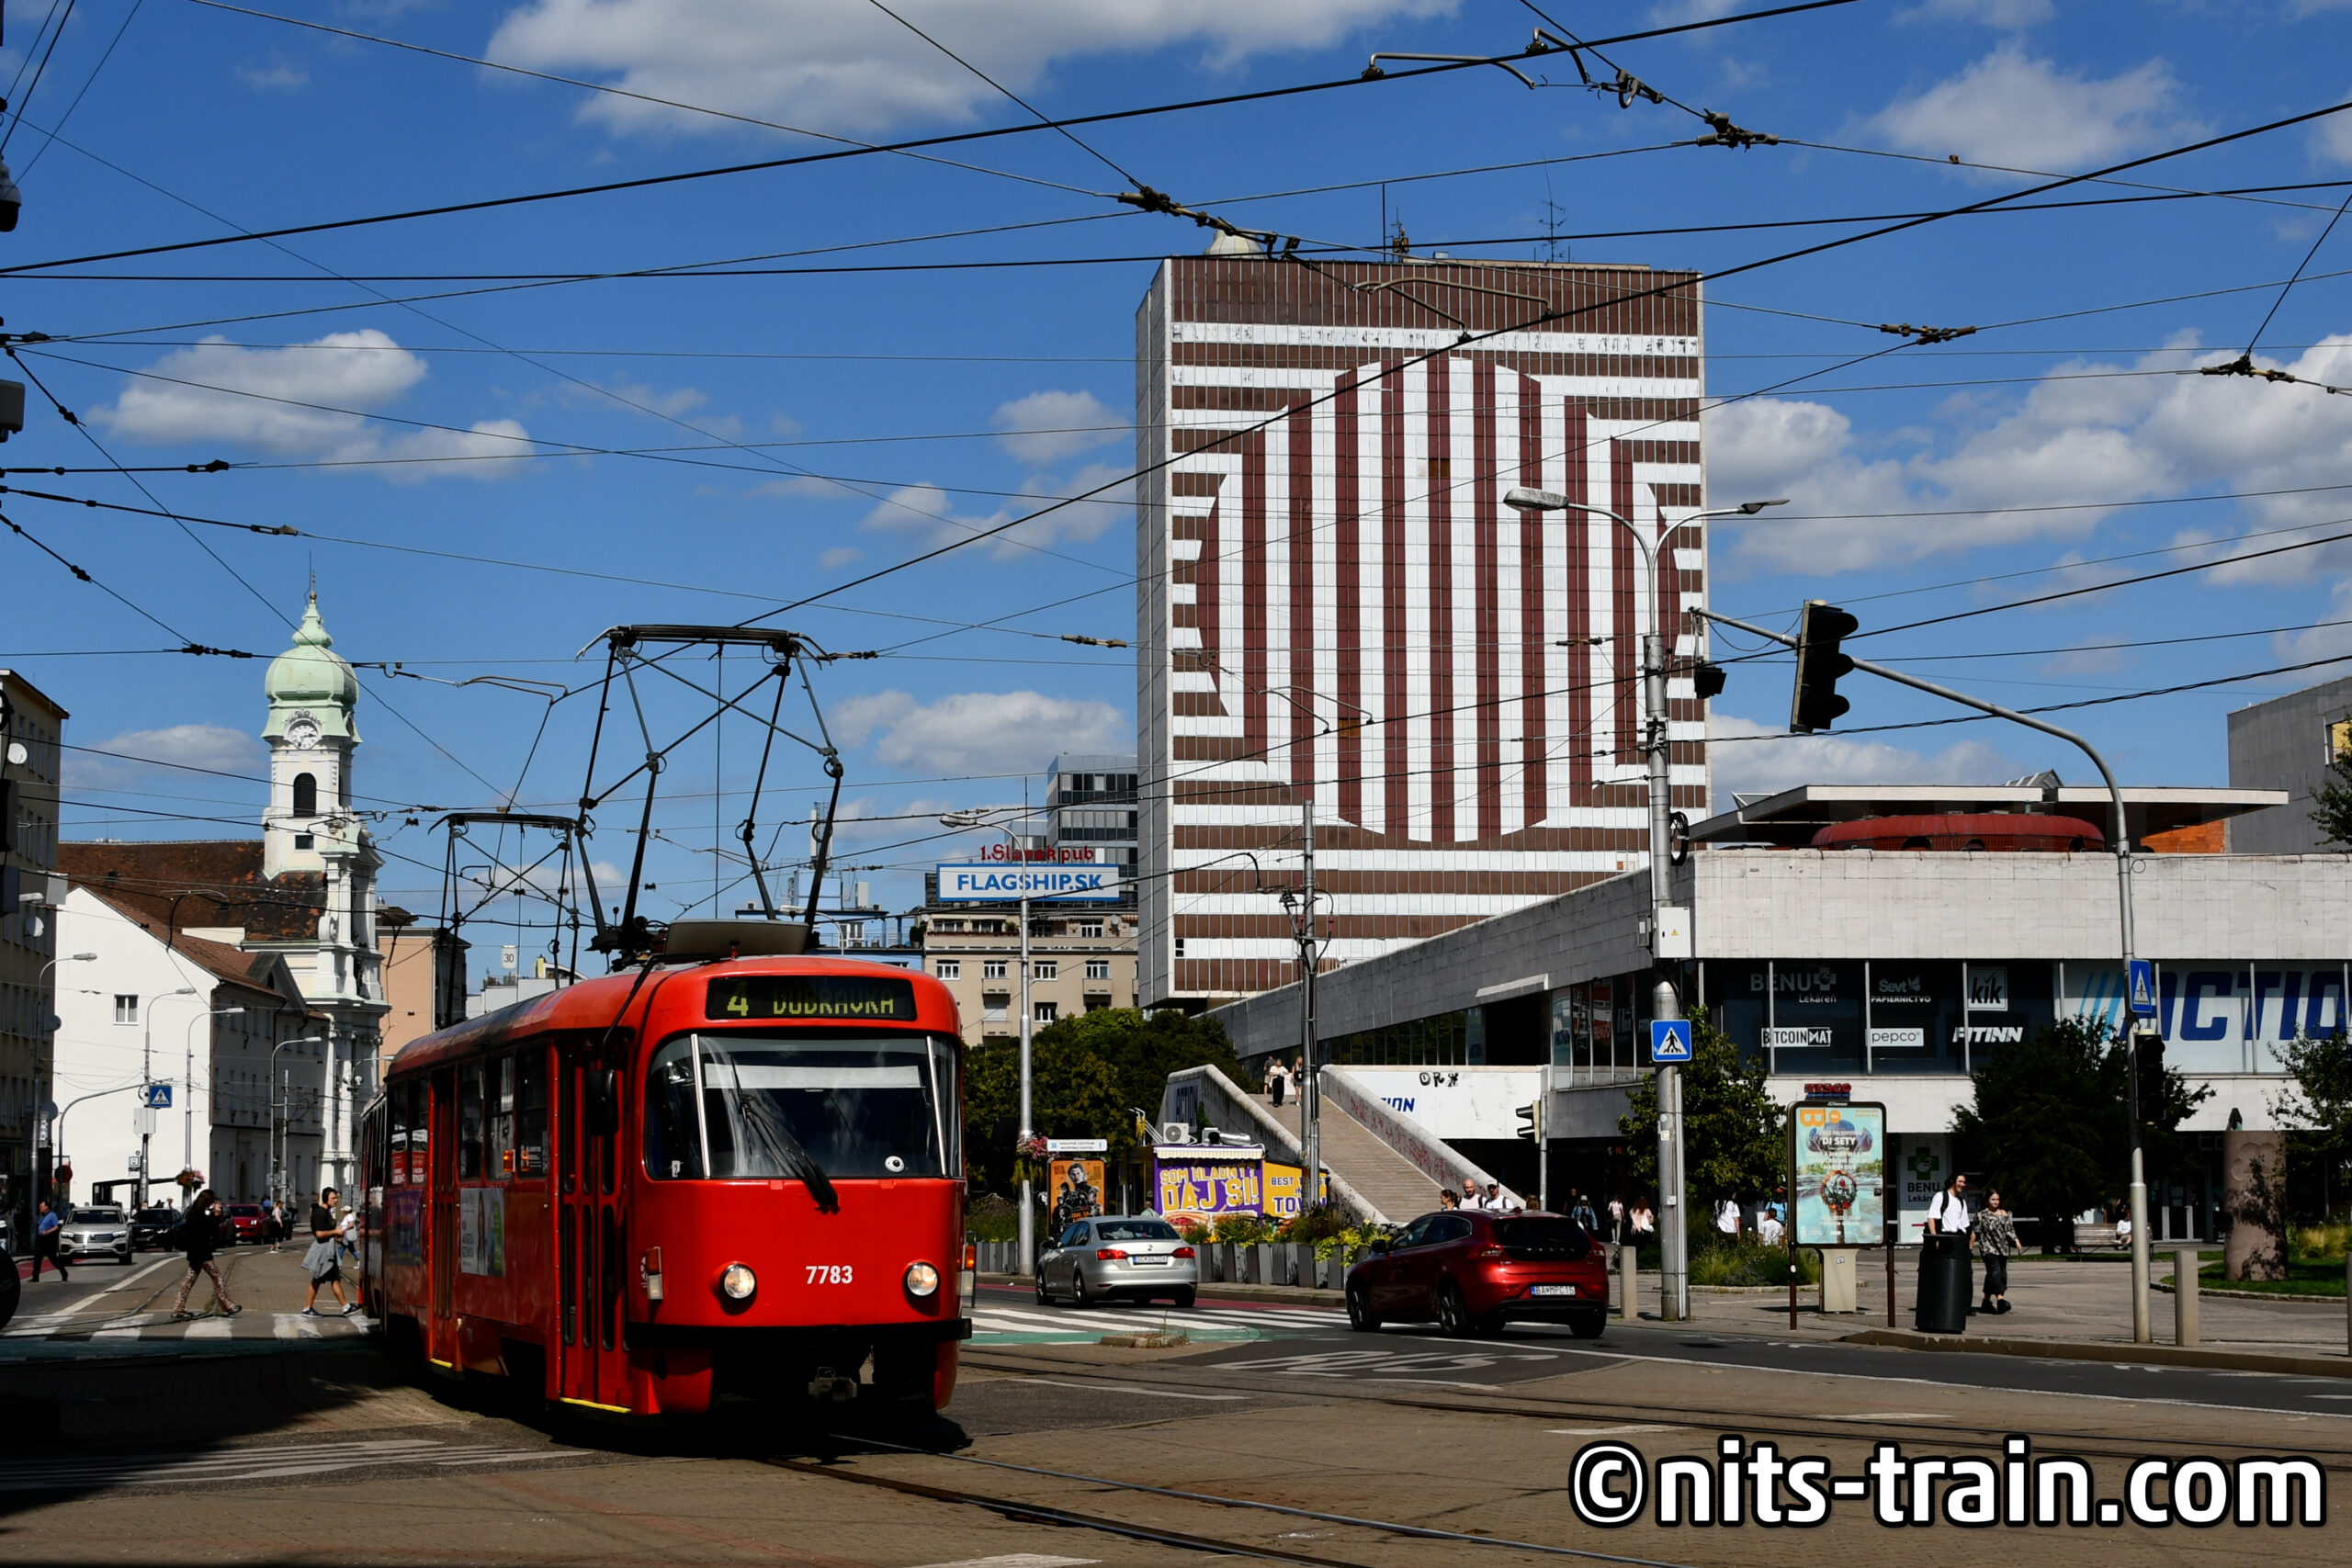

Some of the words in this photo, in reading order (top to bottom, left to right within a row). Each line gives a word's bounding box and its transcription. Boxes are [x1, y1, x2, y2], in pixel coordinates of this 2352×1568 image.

[1061, 845, 1094, 864] pub
[956, 874, 1103, 891] FLAGSHIP.SK
[503, 953, 514, 964] 30
[1750, 973, 1812, 992] BENU
[727, 991, 749, 1017] 4
[1798, 992, 1837, 1004] Lekáreň
[1871, 995, 1931, 1003] PAPIERNICTVO
[2119, 970, 2352, 1042] ACTIO
[1762, 1028, 1833, 1045] BTCOINMAT
[1822, 1136, 1833, 1145] DJ
[1834, 1136, 1857, 1145] SETY
[1159, 1168, 1189, 1185] SOM
[1271, 1177, 1294, 1187] BEST
[1161, 1180, 1217, 1211] DAJ
[1226, 1177, 1260, 1208] SI!
[1907, 1183, 1939, 1192] BENU
[806, 1266, 853, 1284] 7783
